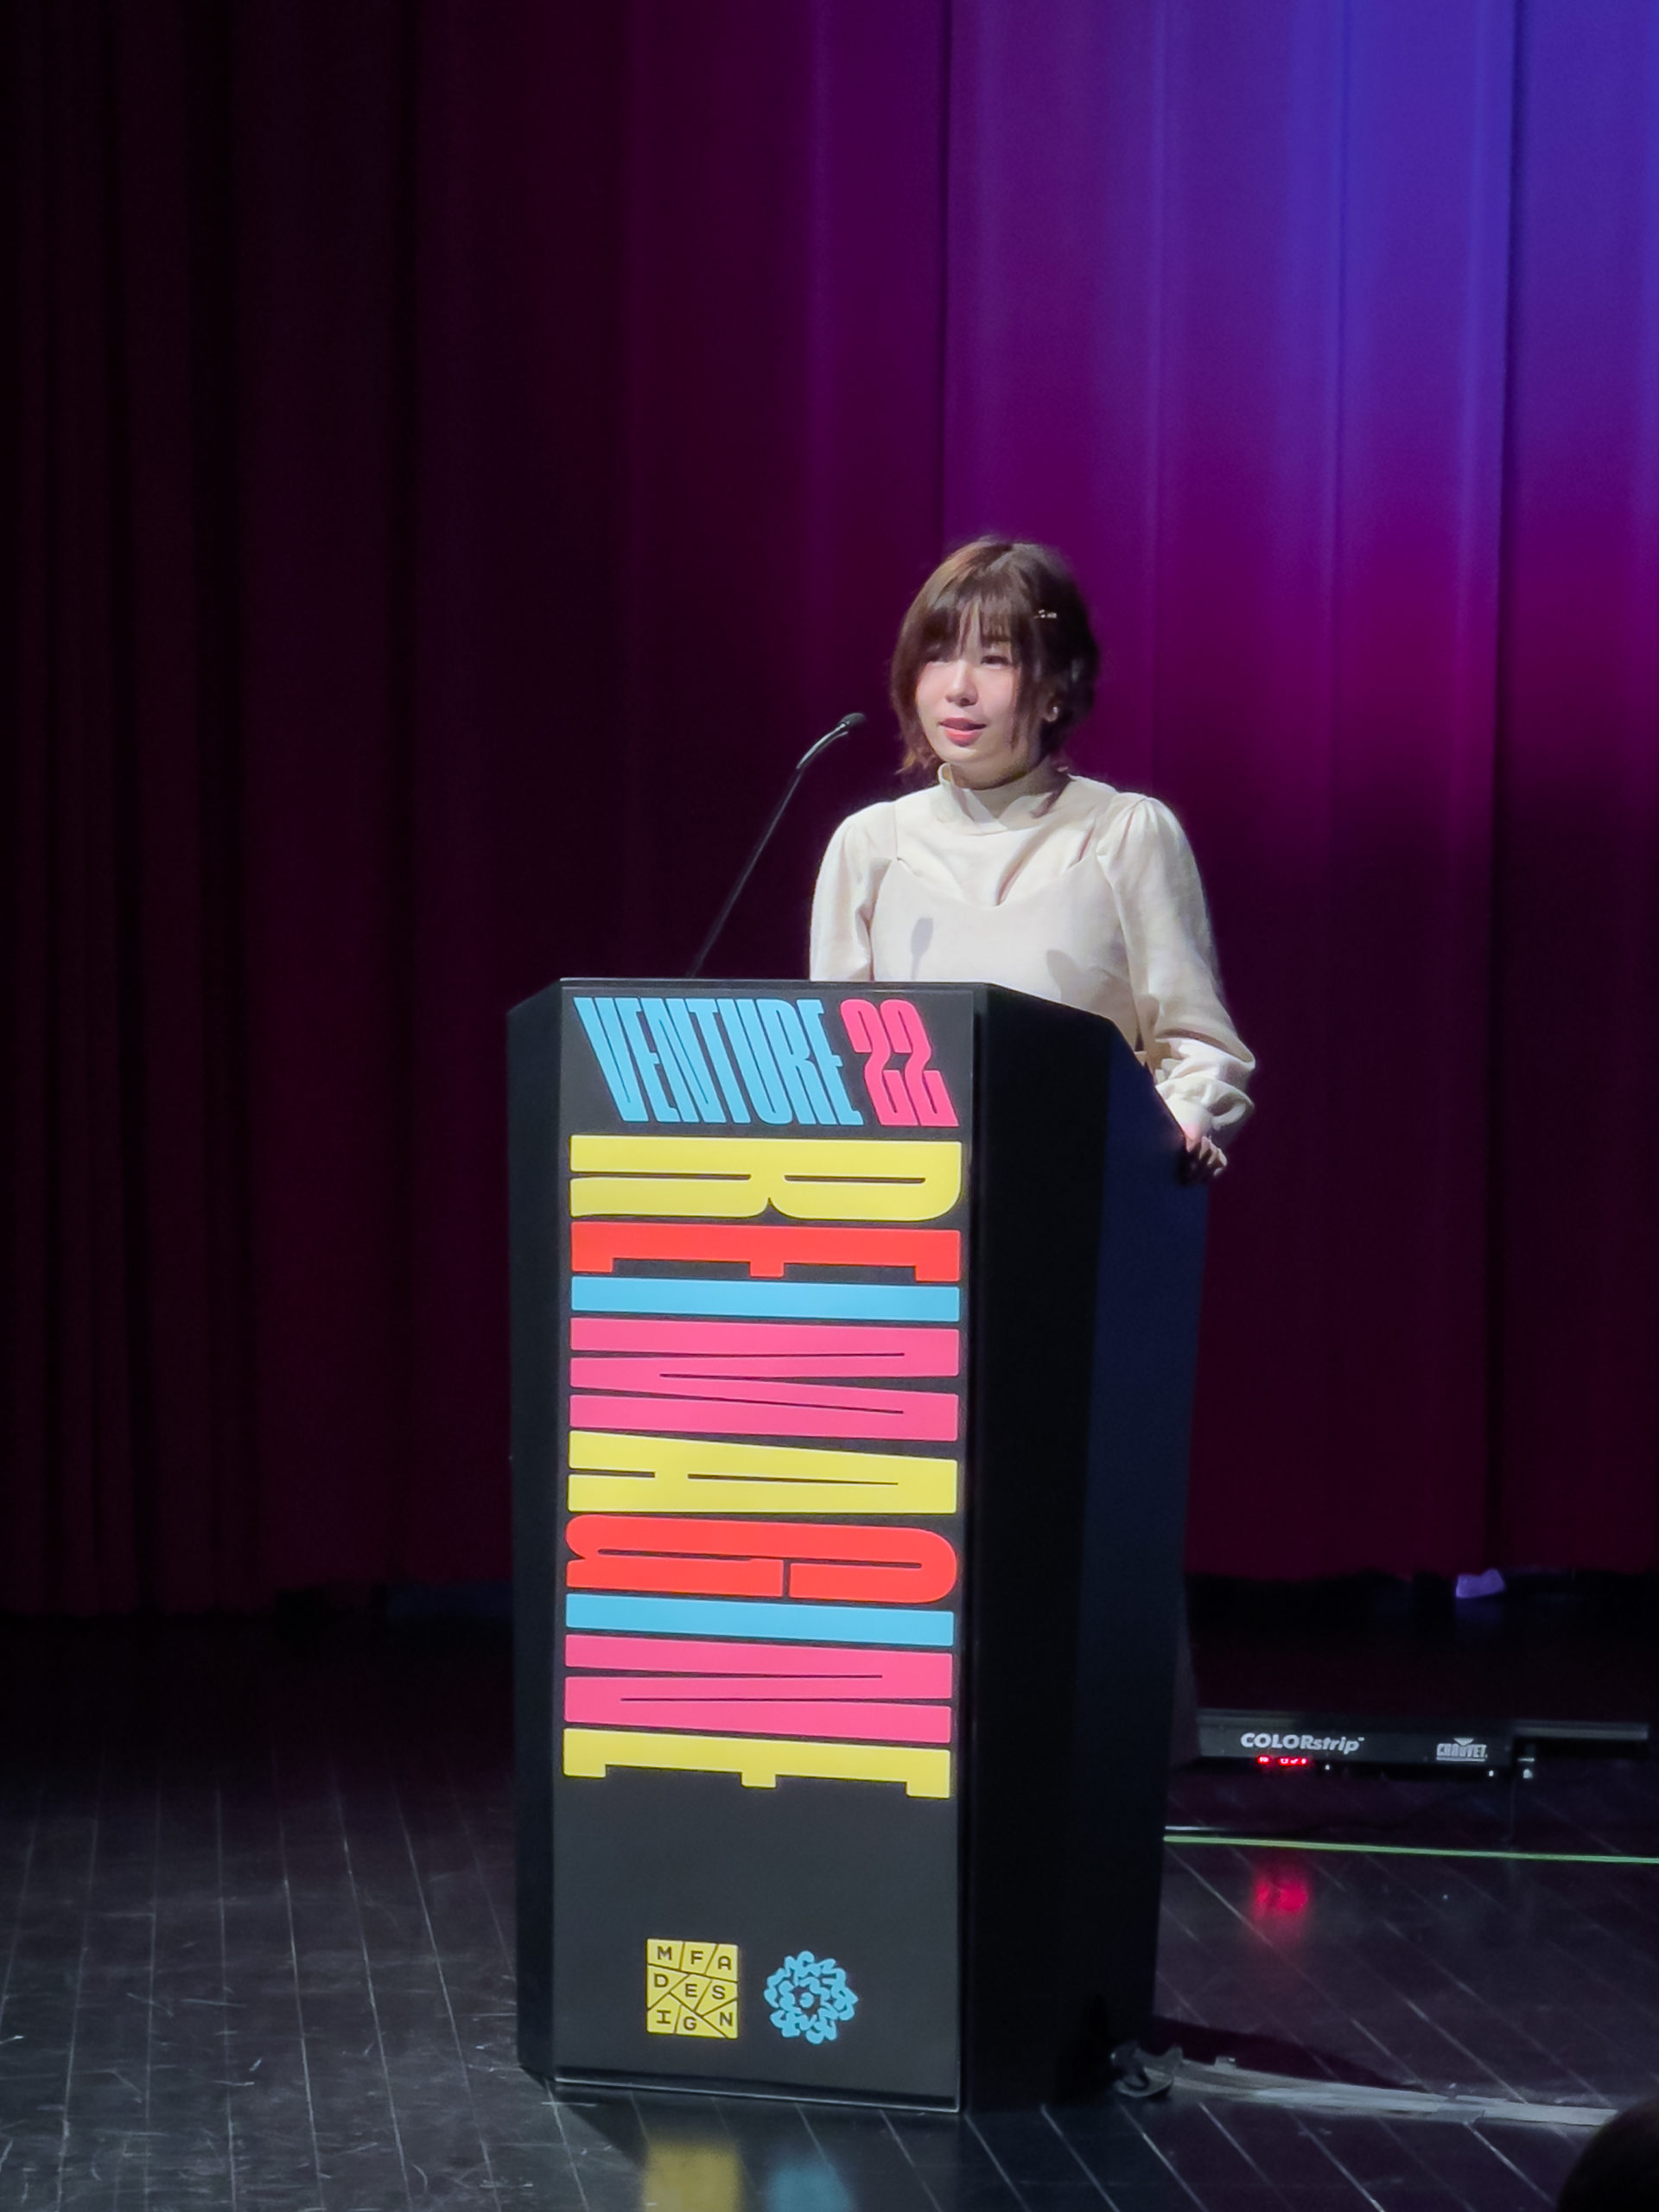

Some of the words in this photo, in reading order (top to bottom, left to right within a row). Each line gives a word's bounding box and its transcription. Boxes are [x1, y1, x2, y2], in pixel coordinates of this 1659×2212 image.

[574, 997, 864, 1126] VENTURE
[840, 999, 959, 1127] 22
[563, 1135, 962, 1799] REIMAGINE
